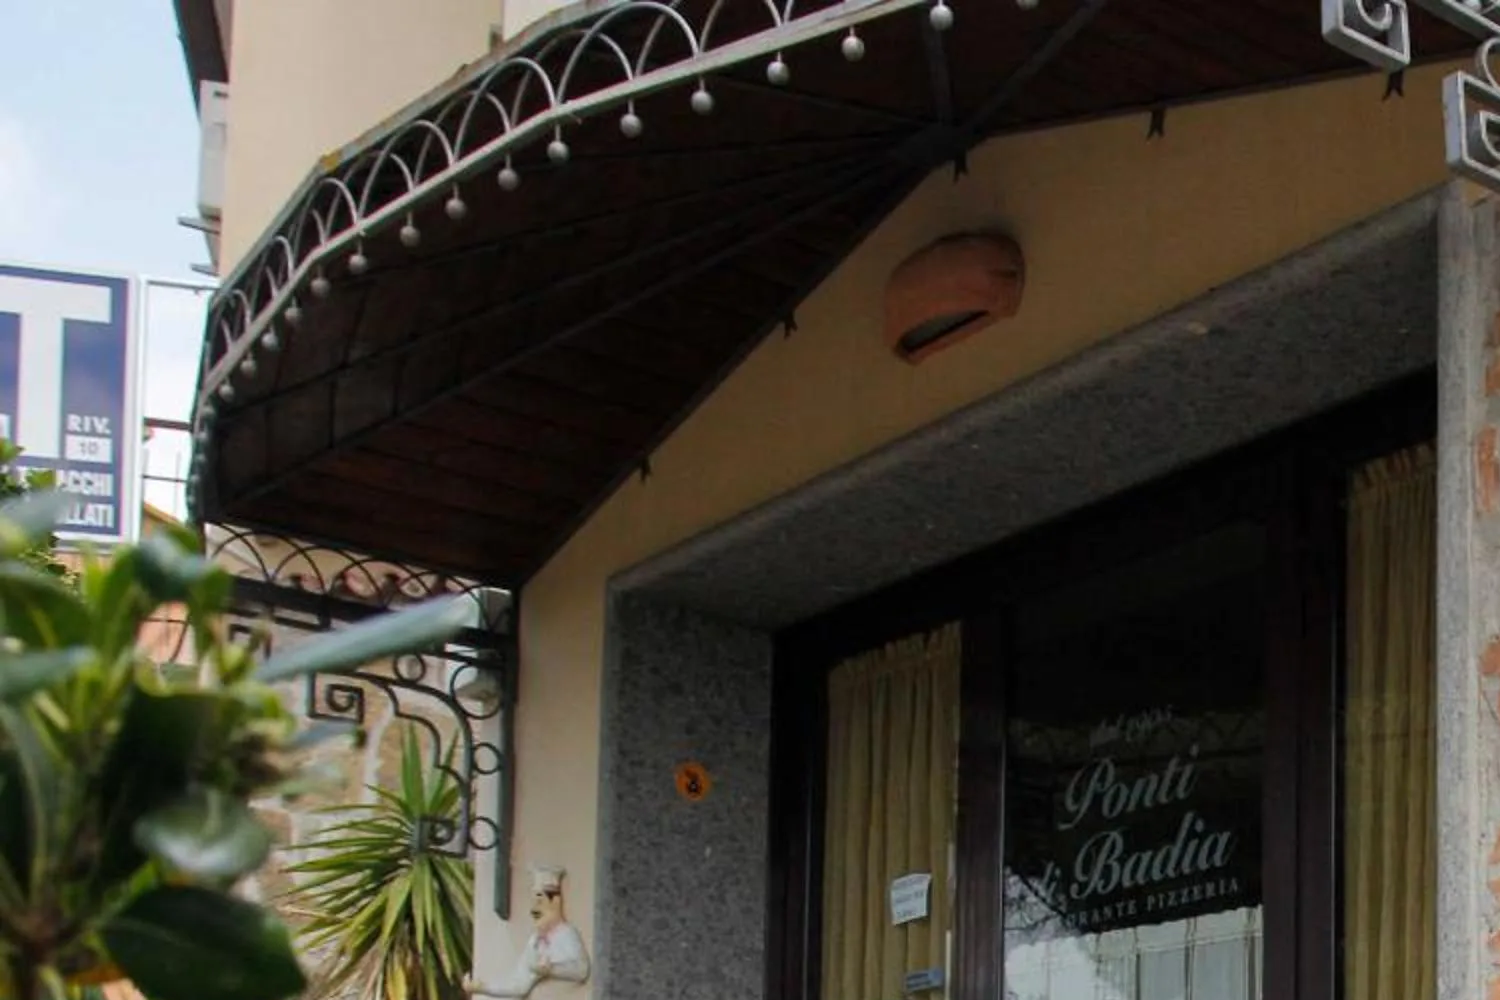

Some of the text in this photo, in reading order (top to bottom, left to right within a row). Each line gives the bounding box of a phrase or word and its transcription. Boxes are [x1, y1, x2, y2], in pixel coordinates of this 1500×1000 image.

[0, 275, 111, 458] T
[66, 413, 111, 434] RIV.
[1058, 744, 1199, 831] Ponti
[1069, 811, 1232, 899] Badia
[1146, 877, 1239, 909] PIZZERIA
